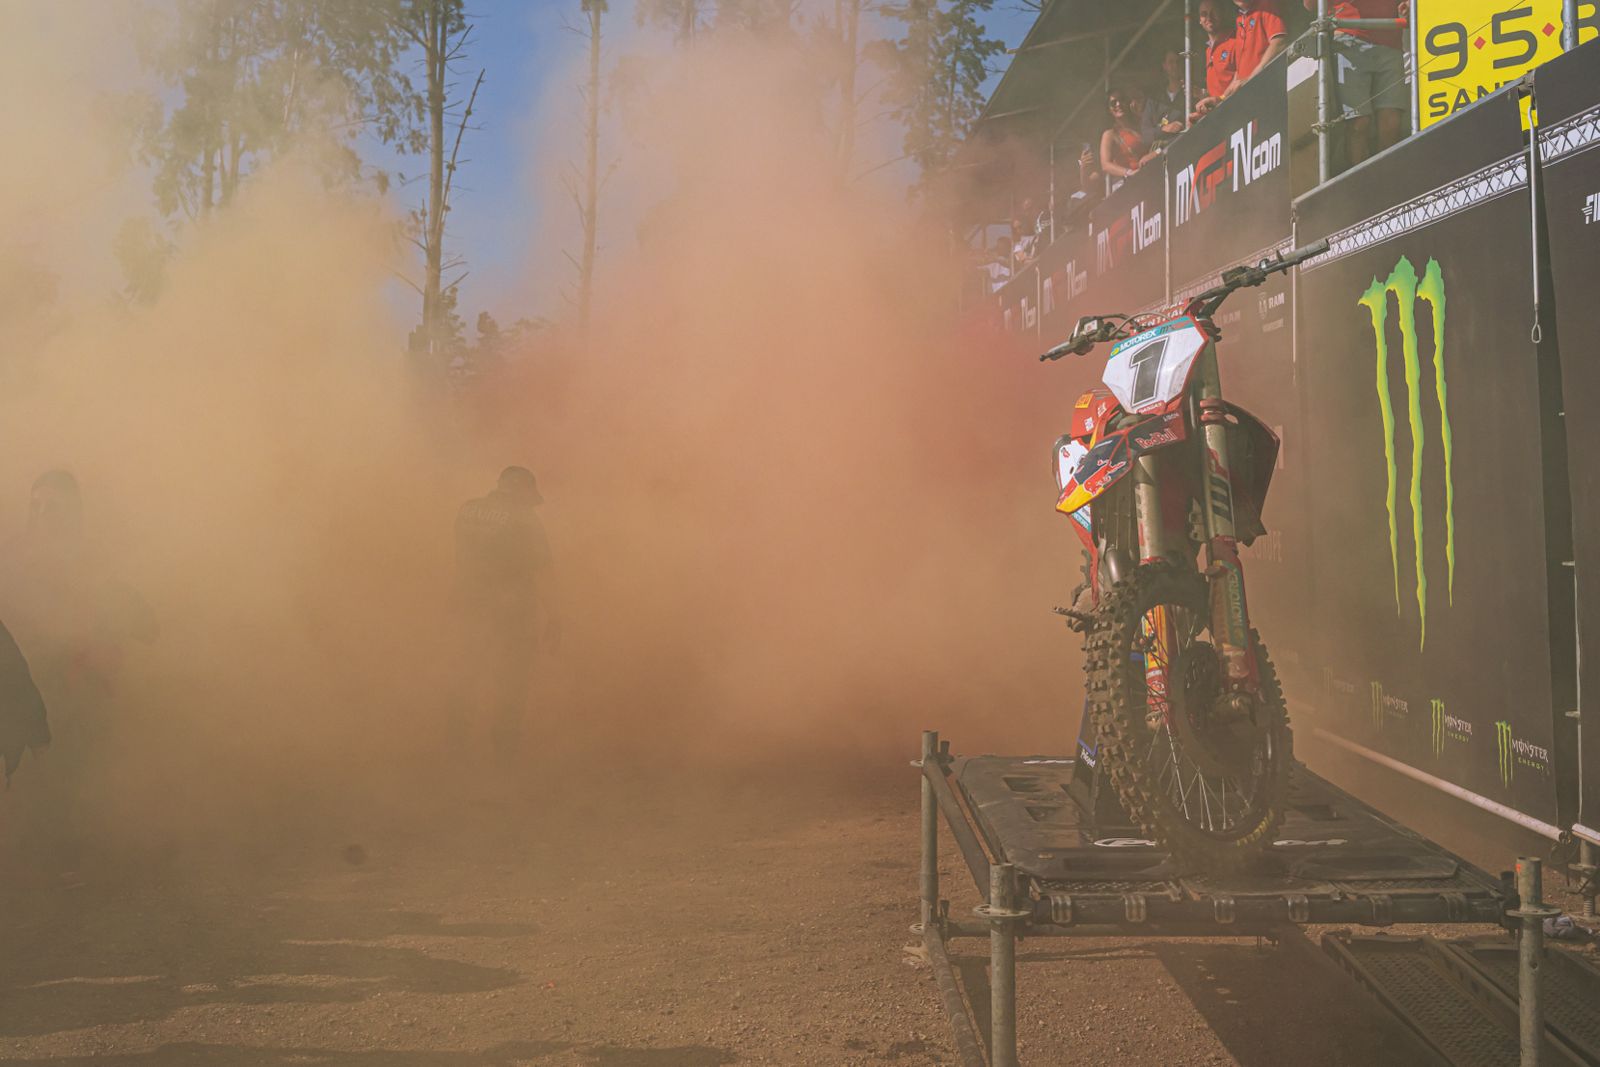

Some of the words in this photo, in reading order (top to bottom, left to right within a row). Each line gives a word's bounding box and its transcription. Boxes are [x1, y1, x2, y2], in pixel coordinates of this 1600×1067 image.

[1129, 334, 1170, 410] 1
[1444, 713, 1472, 736] MONSTER
[1511, 738, 1549, 763] MONSTER
